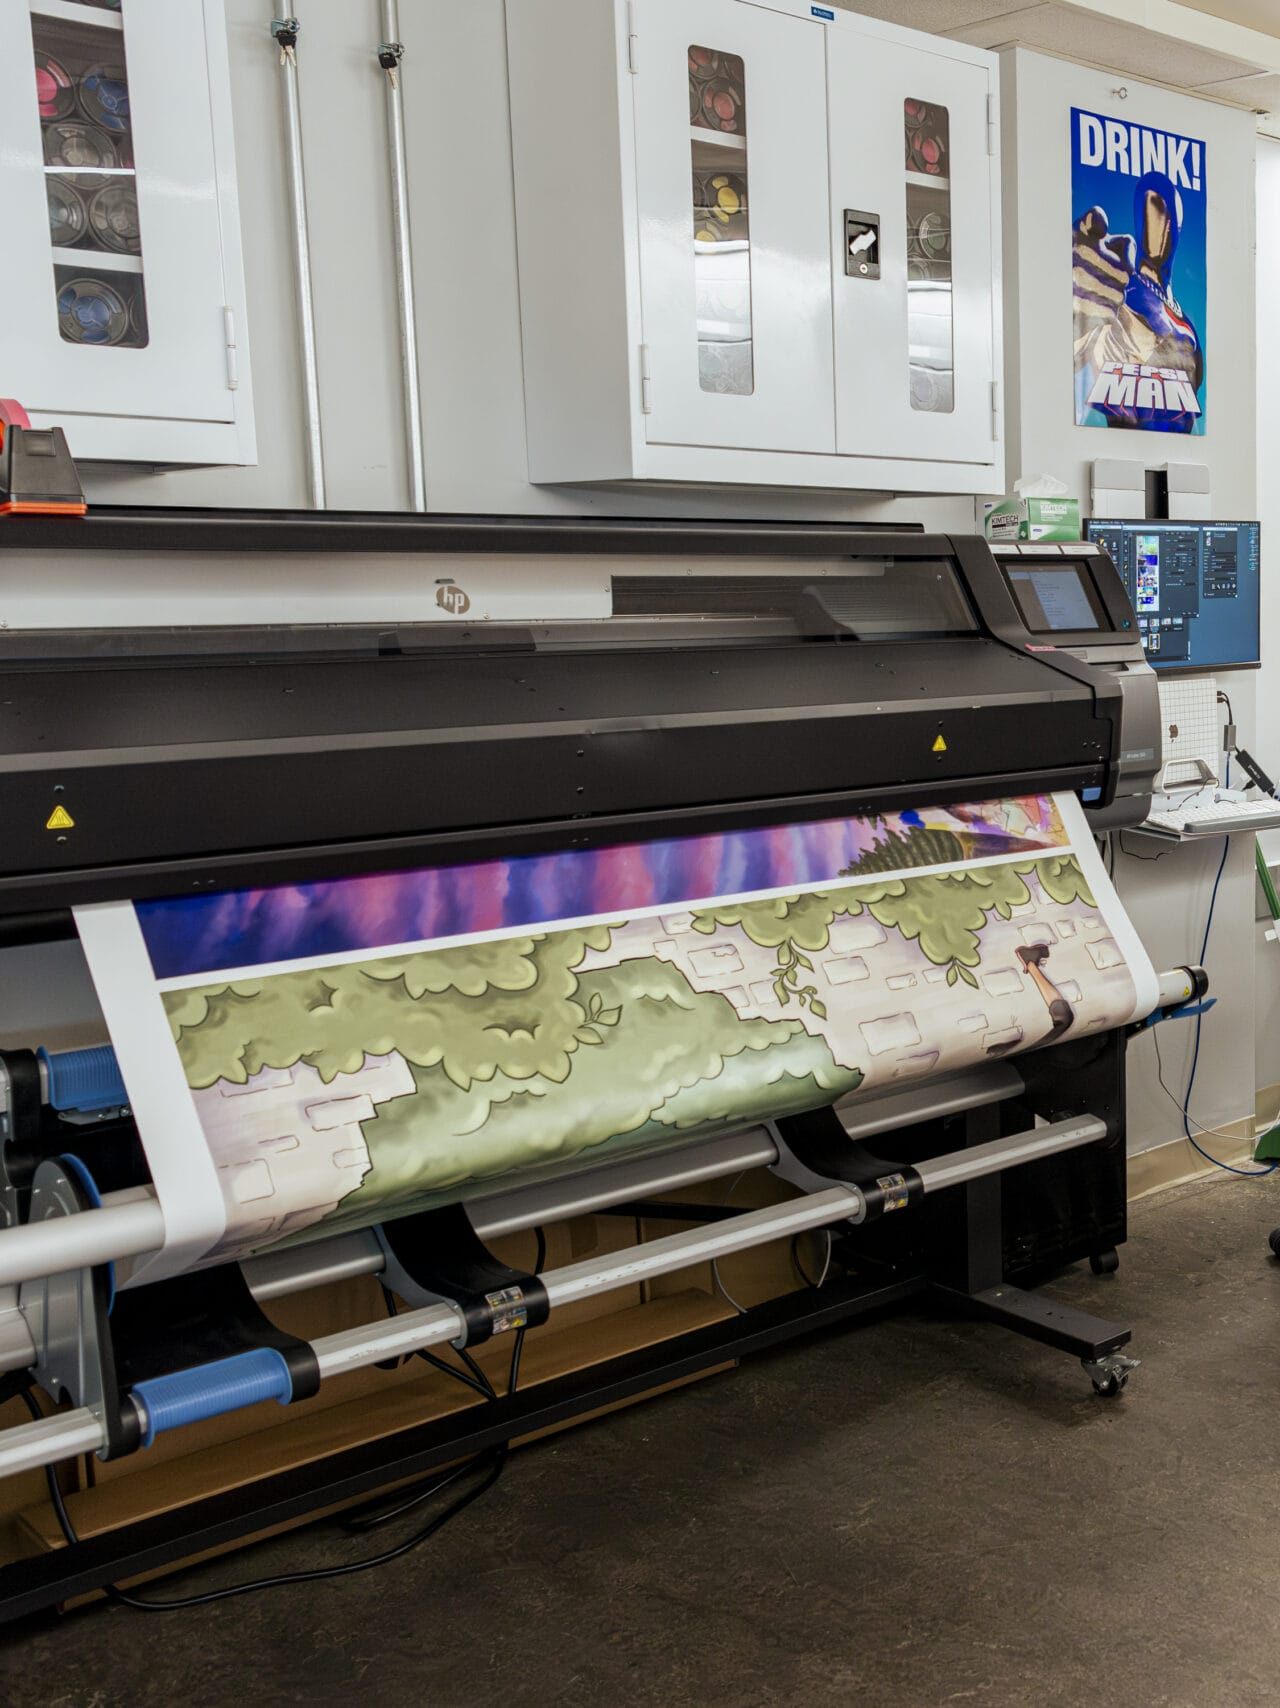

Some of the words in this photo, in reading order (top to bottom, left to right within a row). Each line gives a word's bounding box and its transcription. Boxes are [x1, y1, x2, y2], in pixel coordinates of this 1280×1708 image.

[1079, 112, 1201, 191] DRINK!
[1101, 361, 1191, 382] PEPSI
[1086, 371, 1201, 413] MAN
[991, 514, 1019, 525] KIMTECH
[441, 585, 467, 614] hp
